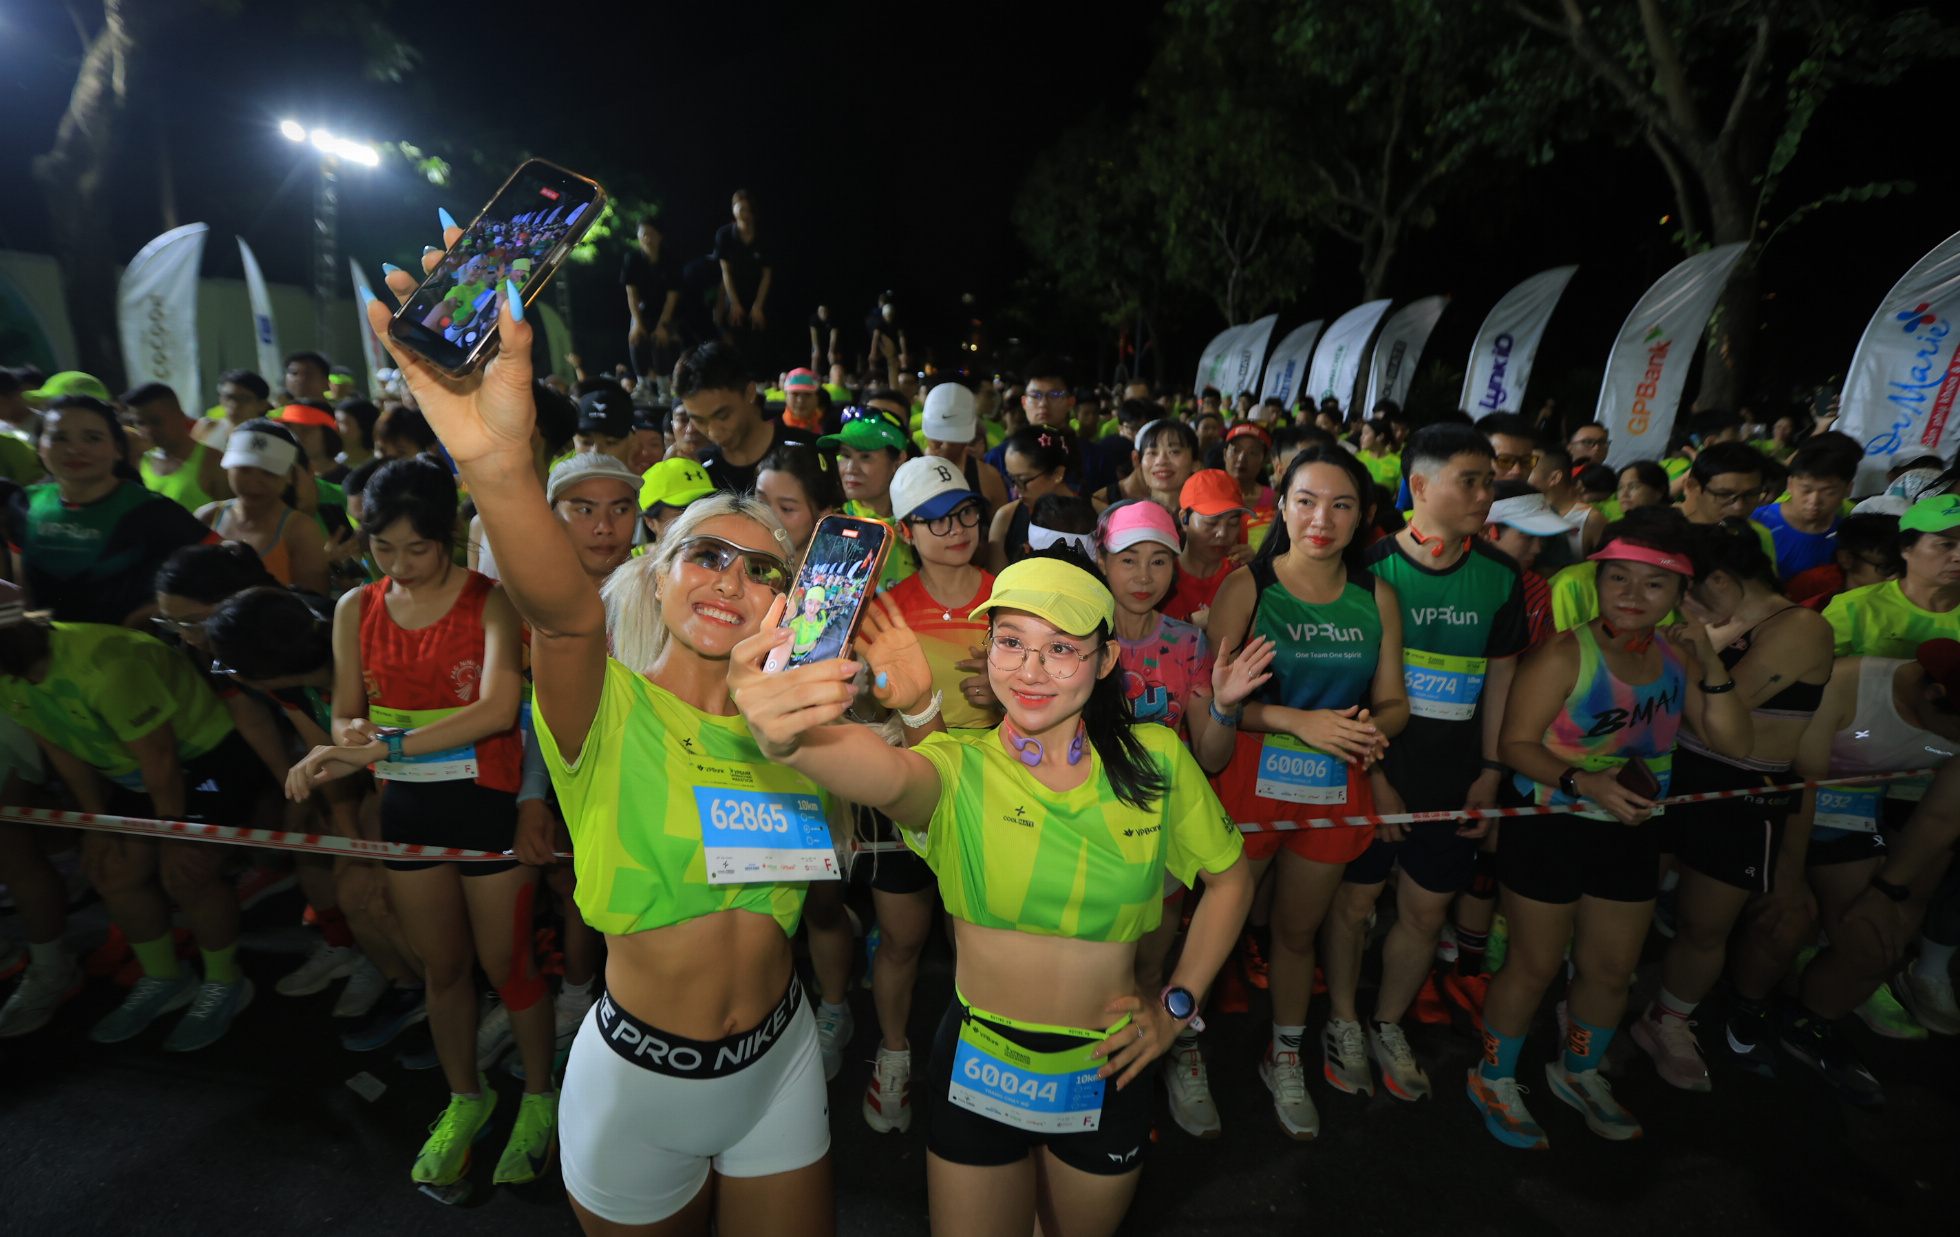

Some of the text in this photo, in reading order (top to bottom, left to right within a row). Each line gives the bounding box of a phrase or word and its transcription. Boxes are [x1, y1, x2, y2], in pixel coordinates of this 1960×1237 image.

[1886, 318, 1951, 415] Marie
[1628, 339, 1673, 435] GPBank
[933, 465, 952, 482] B
[1411, 605, 1479, 625] VPRun
[1286, 622, 1364, 642] VPRun
[1344, 652, 1362, 660] Spirit
[1404, 671, 1457, 695] 62774
[1266, 753, 1327, 778] 60006
[1816, 792, 1852, 809] 932
[711, 798, 788, 833] 62865
[824, 858, 832, 871] F
[611, 1018, 702, 1071] PRO
[713, 998, 788, 1071] NIKE
[965, 1056, 1059, 1102] 60044
[1083, 1115, 1093, 1126] F
